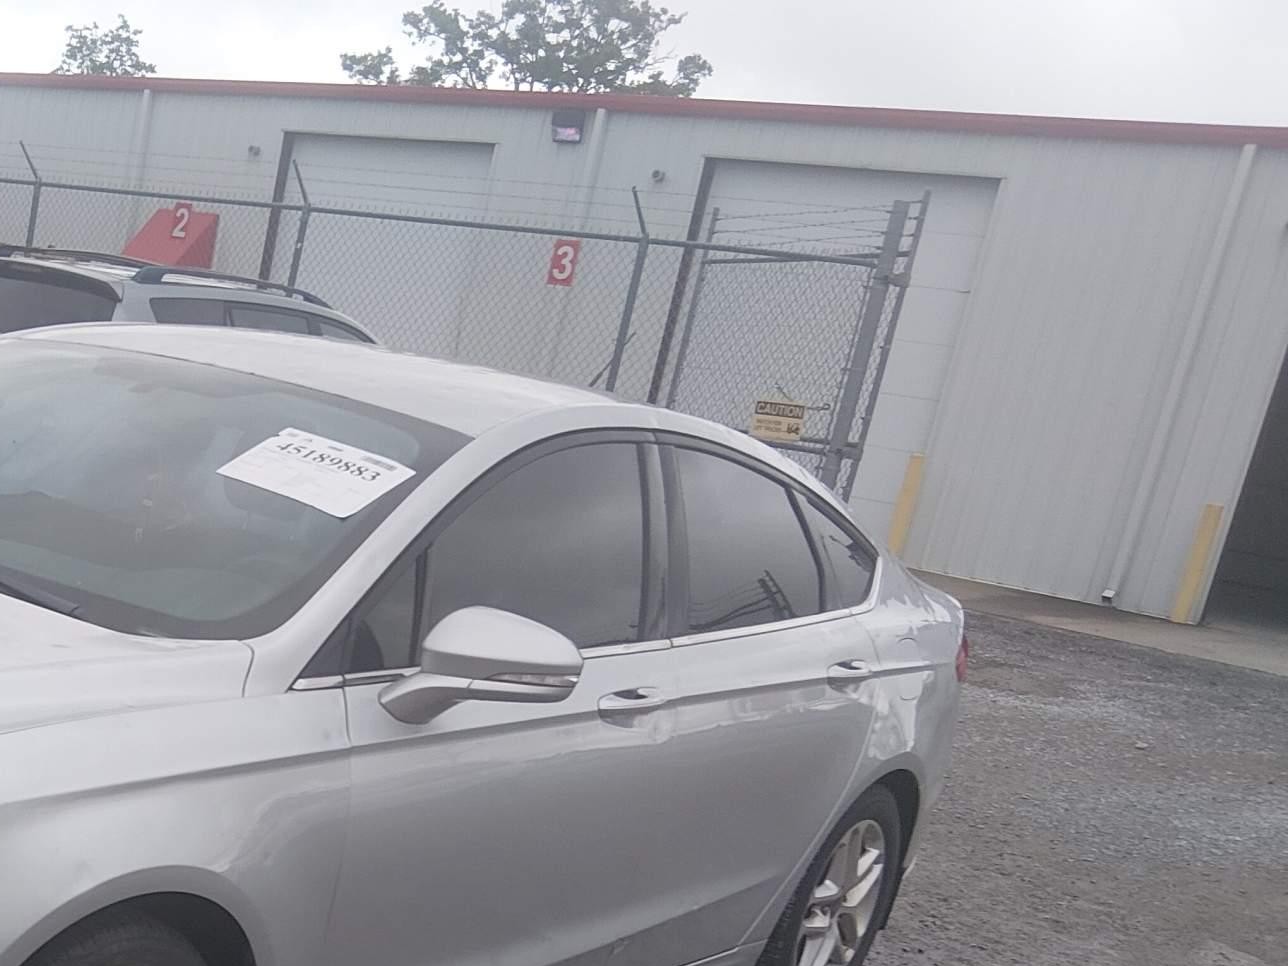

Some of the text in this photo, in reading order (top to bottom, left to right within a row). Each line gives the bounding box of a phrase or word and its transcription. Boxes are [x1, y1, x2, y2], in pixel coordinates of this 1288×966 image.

[172, 208, 189, 238] 2
[552, 246, 575, 280] 3
[756, 402, 804, 419] CAUTION
[276, 442, 382, 482] 45189883
